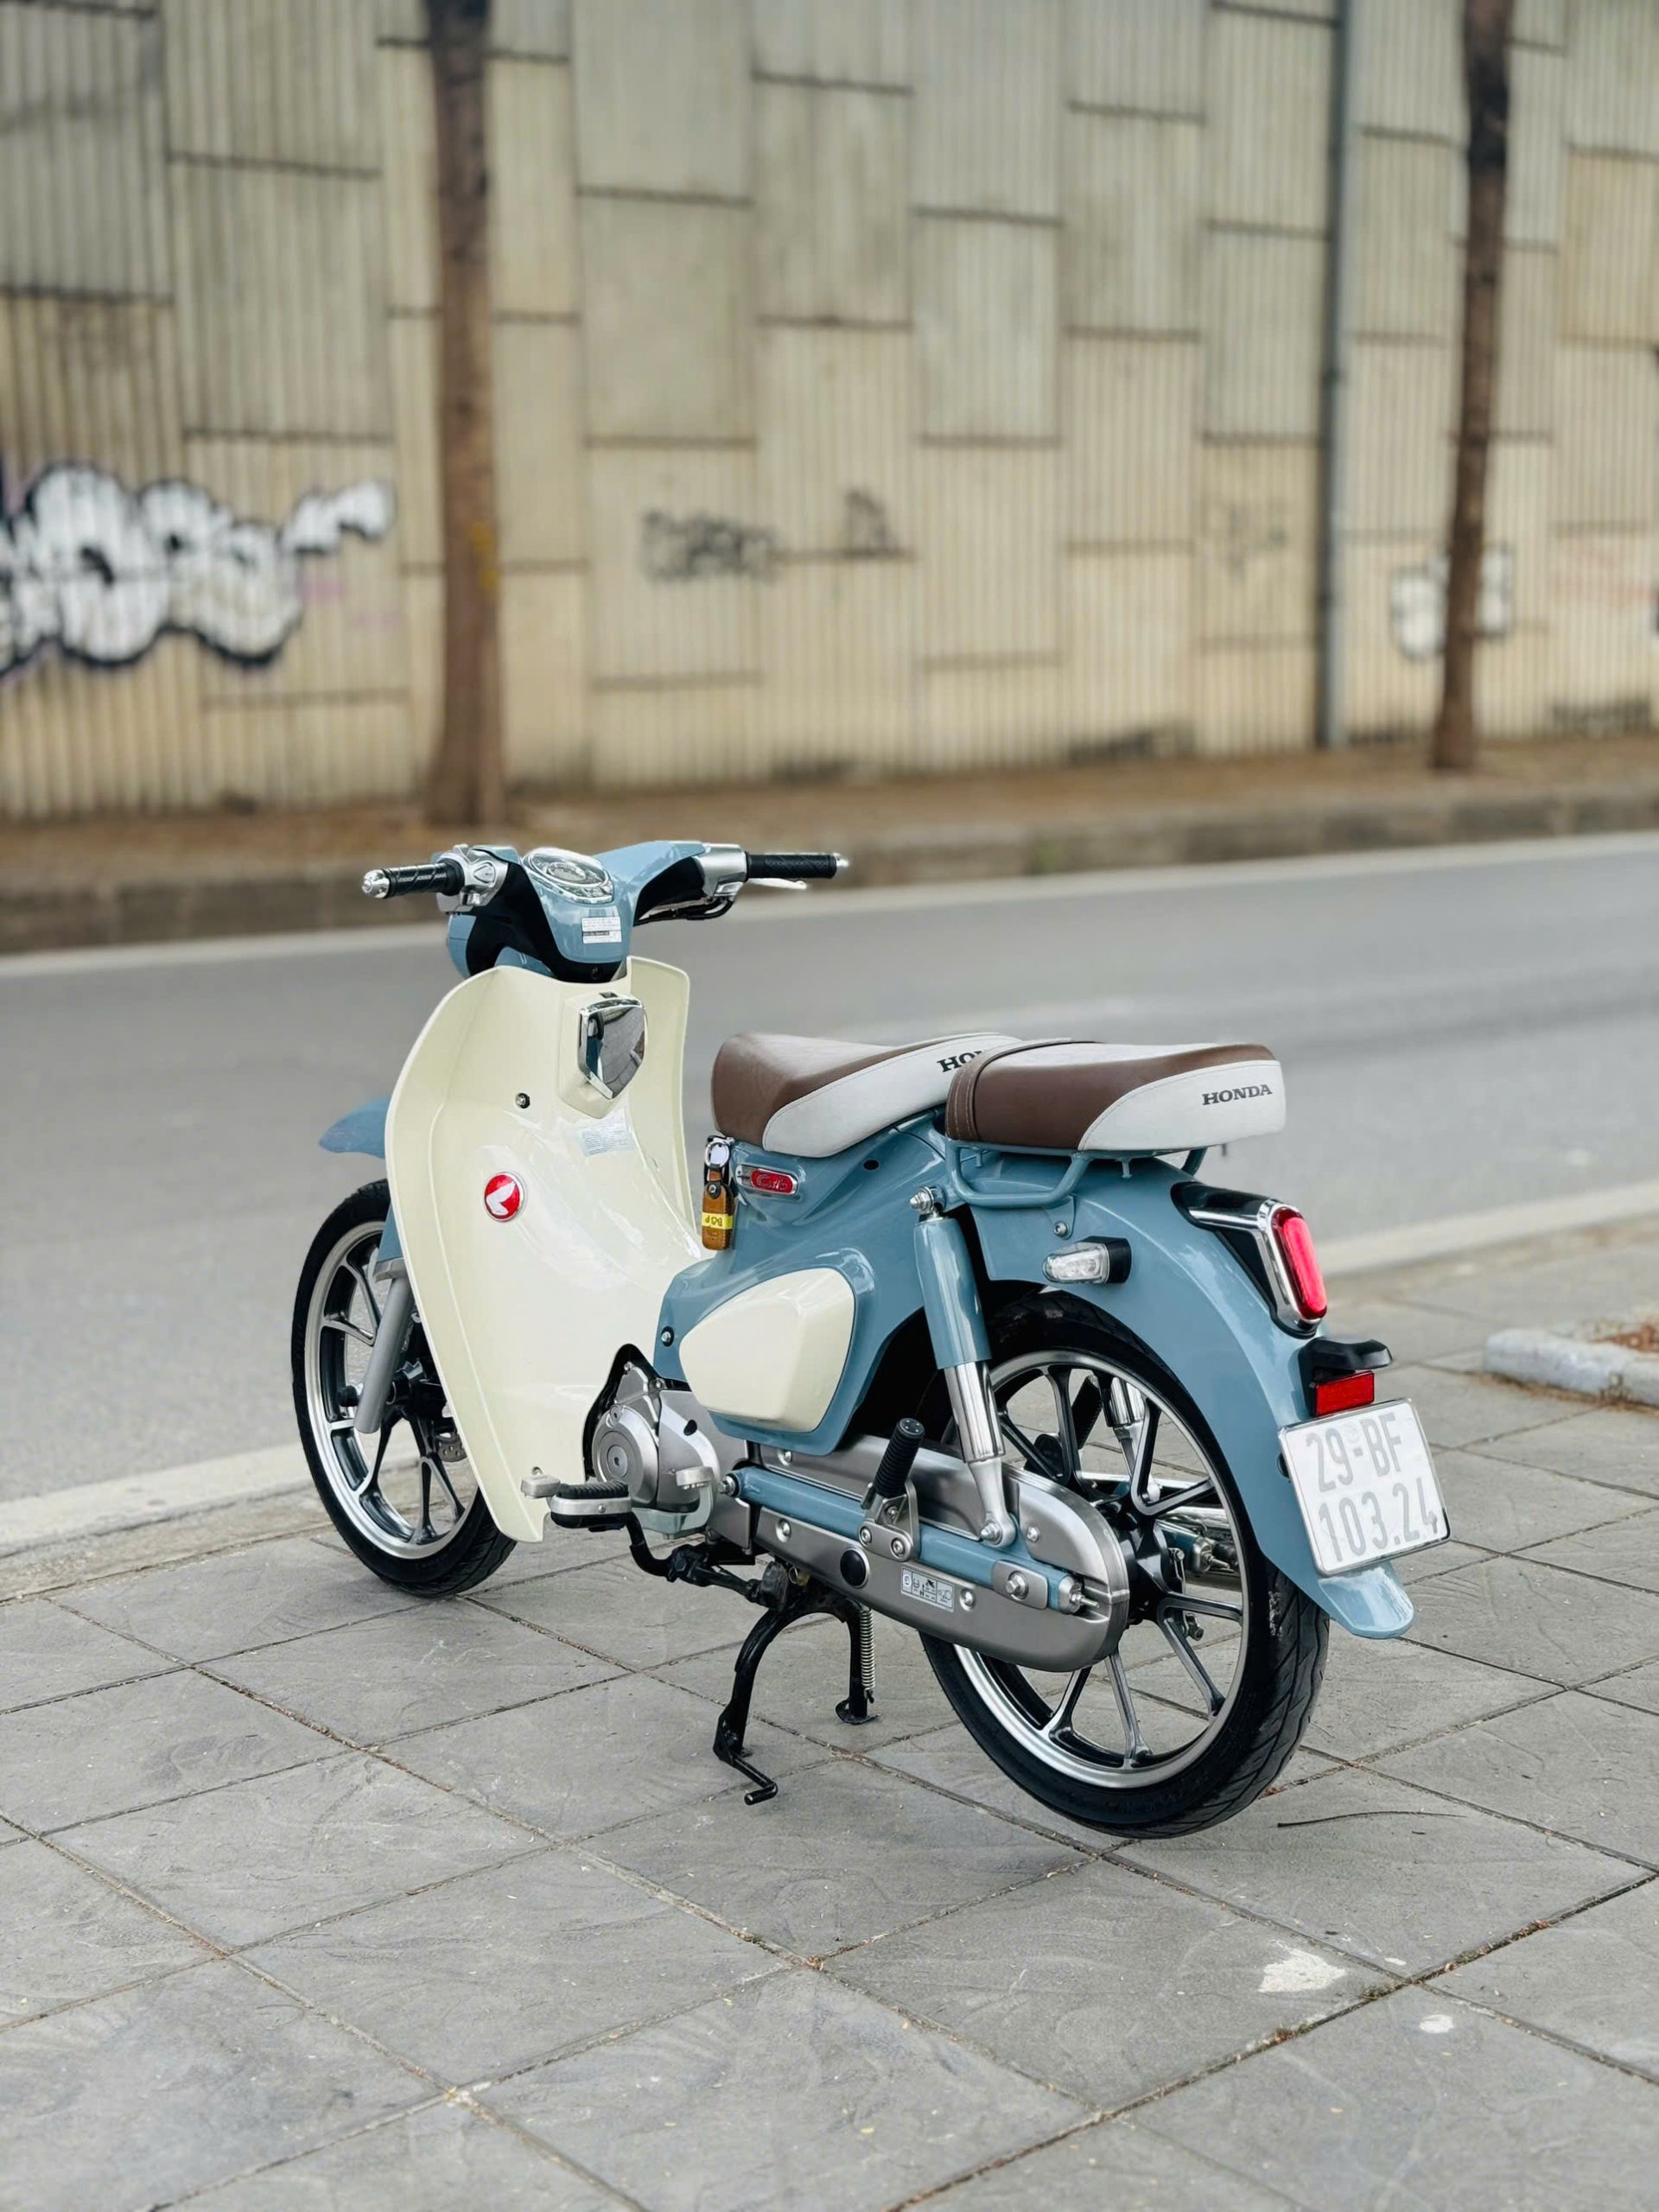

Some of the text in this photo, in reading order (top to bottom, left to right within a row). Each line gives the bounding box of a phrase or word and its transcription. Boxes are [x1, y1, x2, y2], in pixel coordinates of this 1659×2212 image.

[1202, 1084, 1273, 1105] HONDA
[1306, 1413, 1402, 1492] 29-BF
[1319, 1478, 1438, 1561] 103.24
